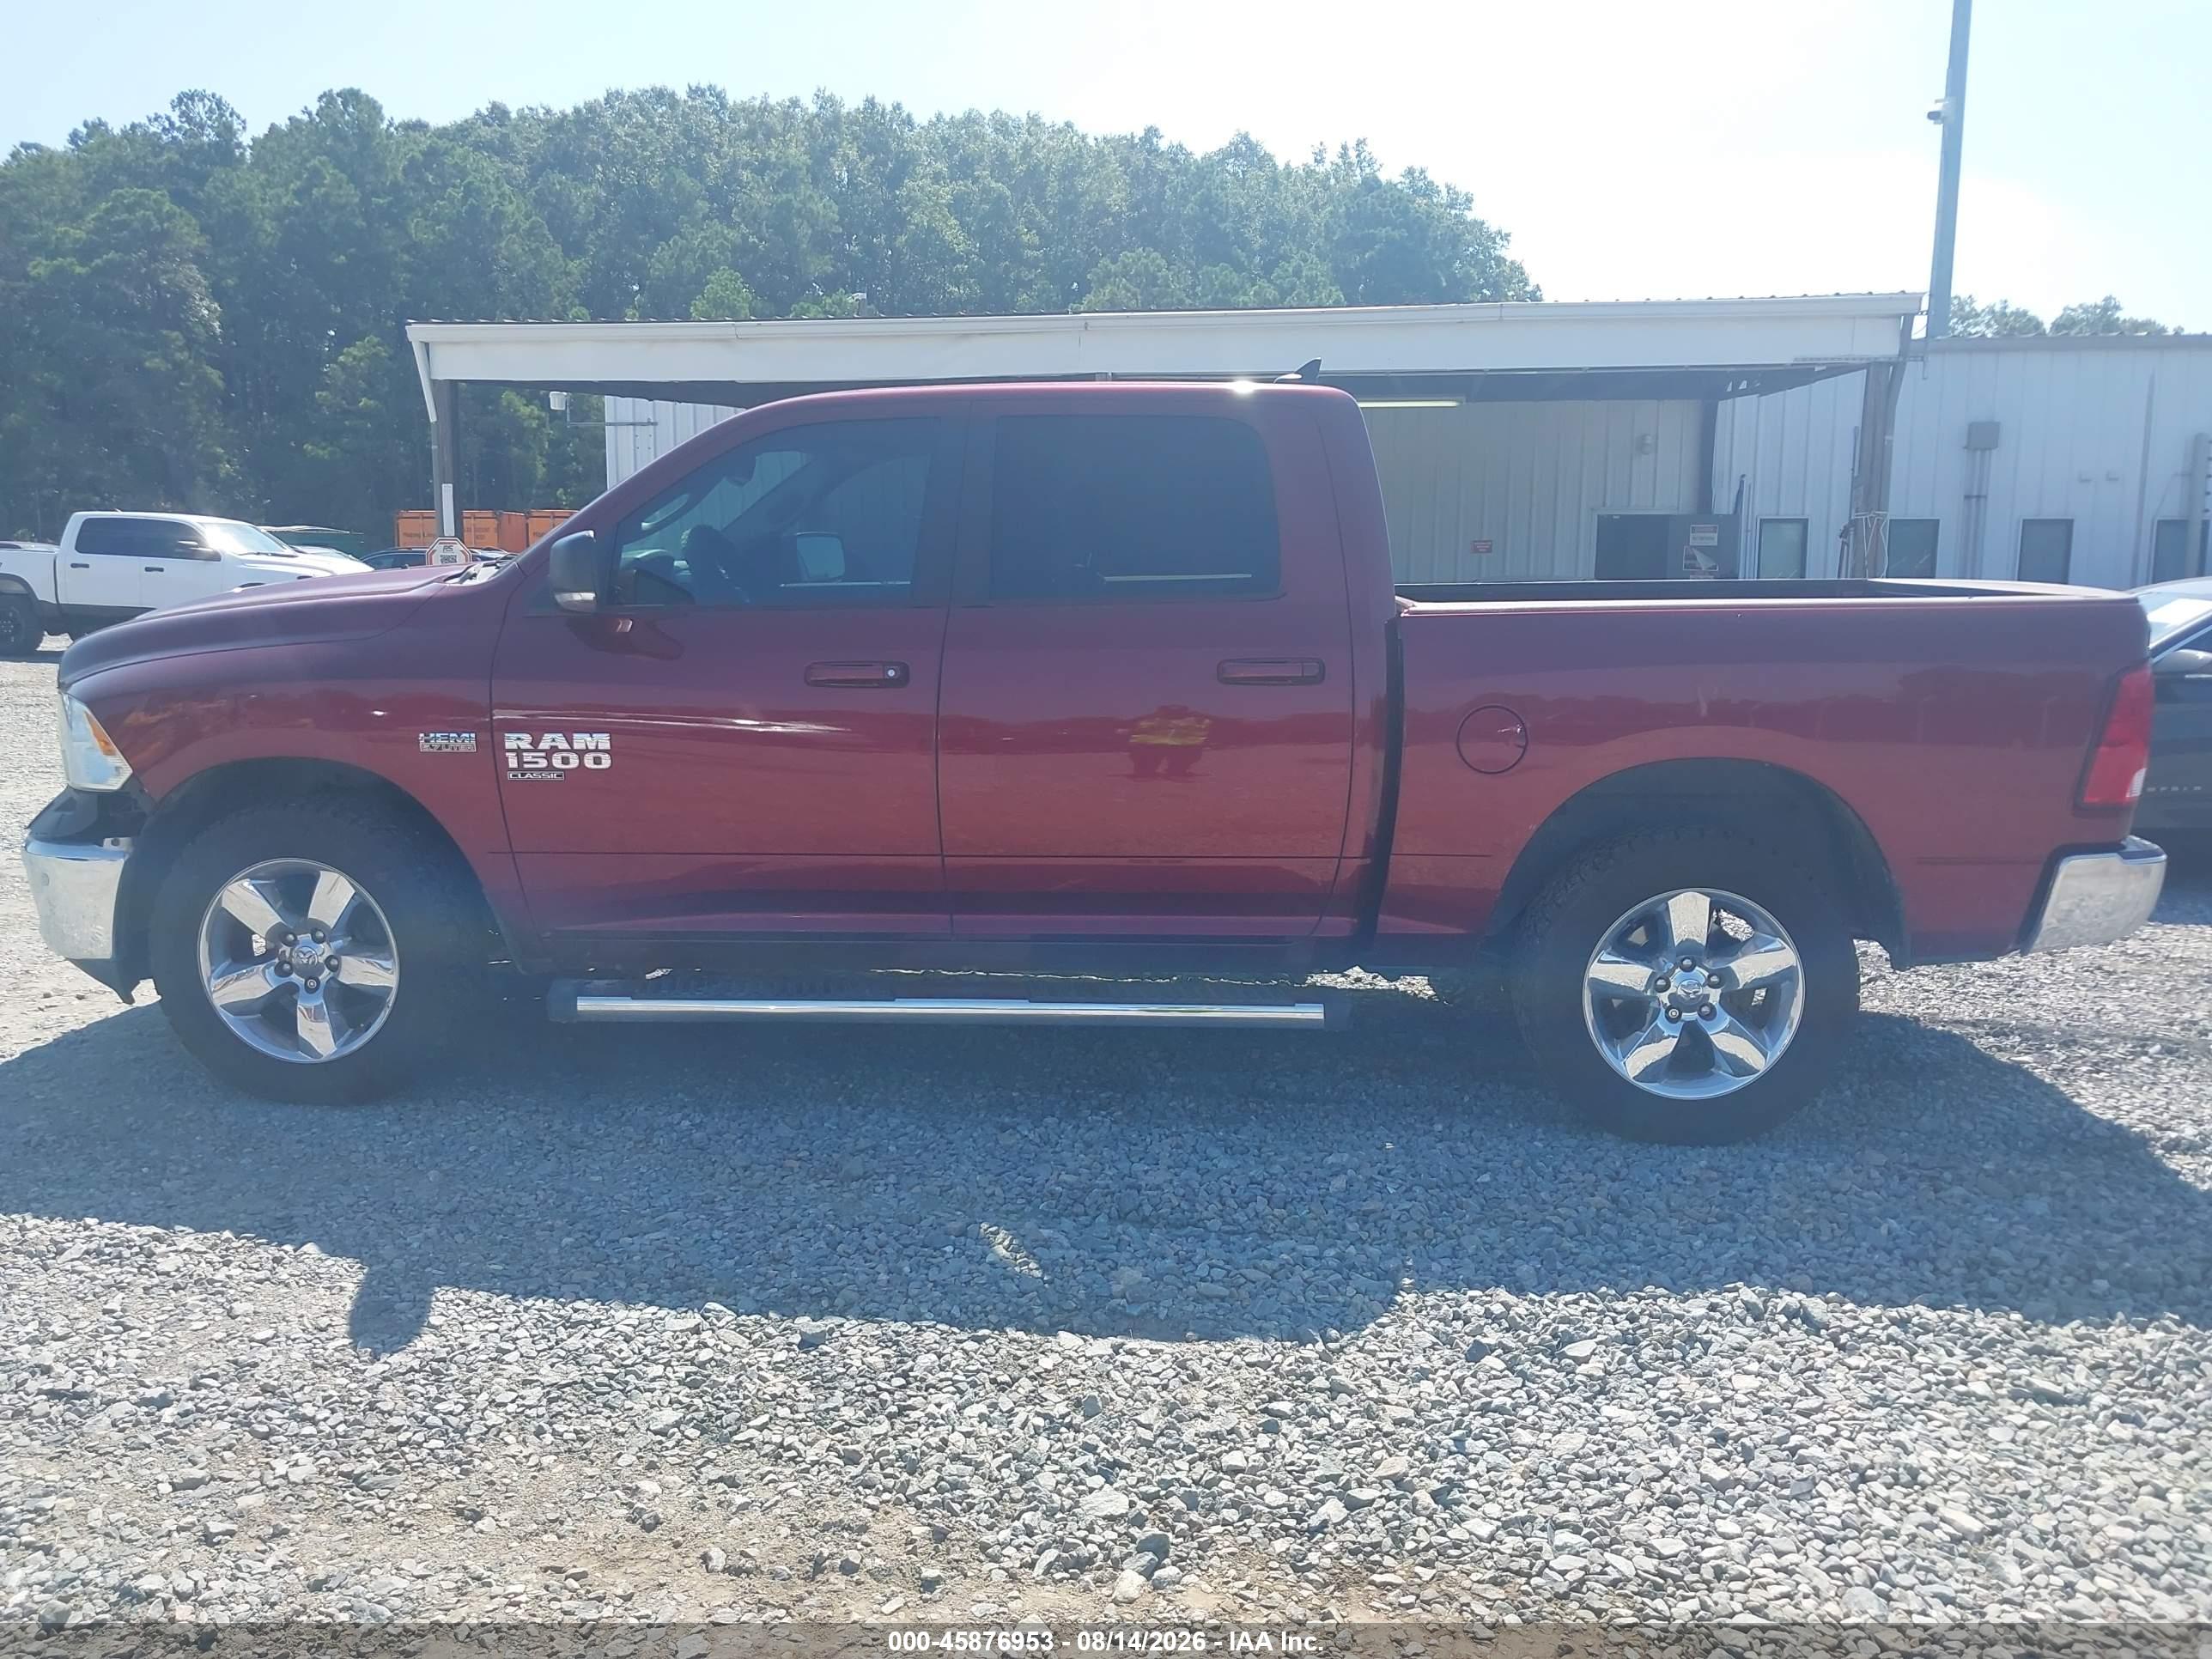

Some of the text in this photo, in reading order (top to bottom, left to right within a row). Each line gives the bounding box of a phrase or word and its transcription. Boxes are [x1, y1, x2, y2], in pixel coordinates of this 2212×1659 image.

[419, 732, 476, 742] HEMI
[504, 732, 611, 750] RAM
[506, 751, 611, 769] 1500
